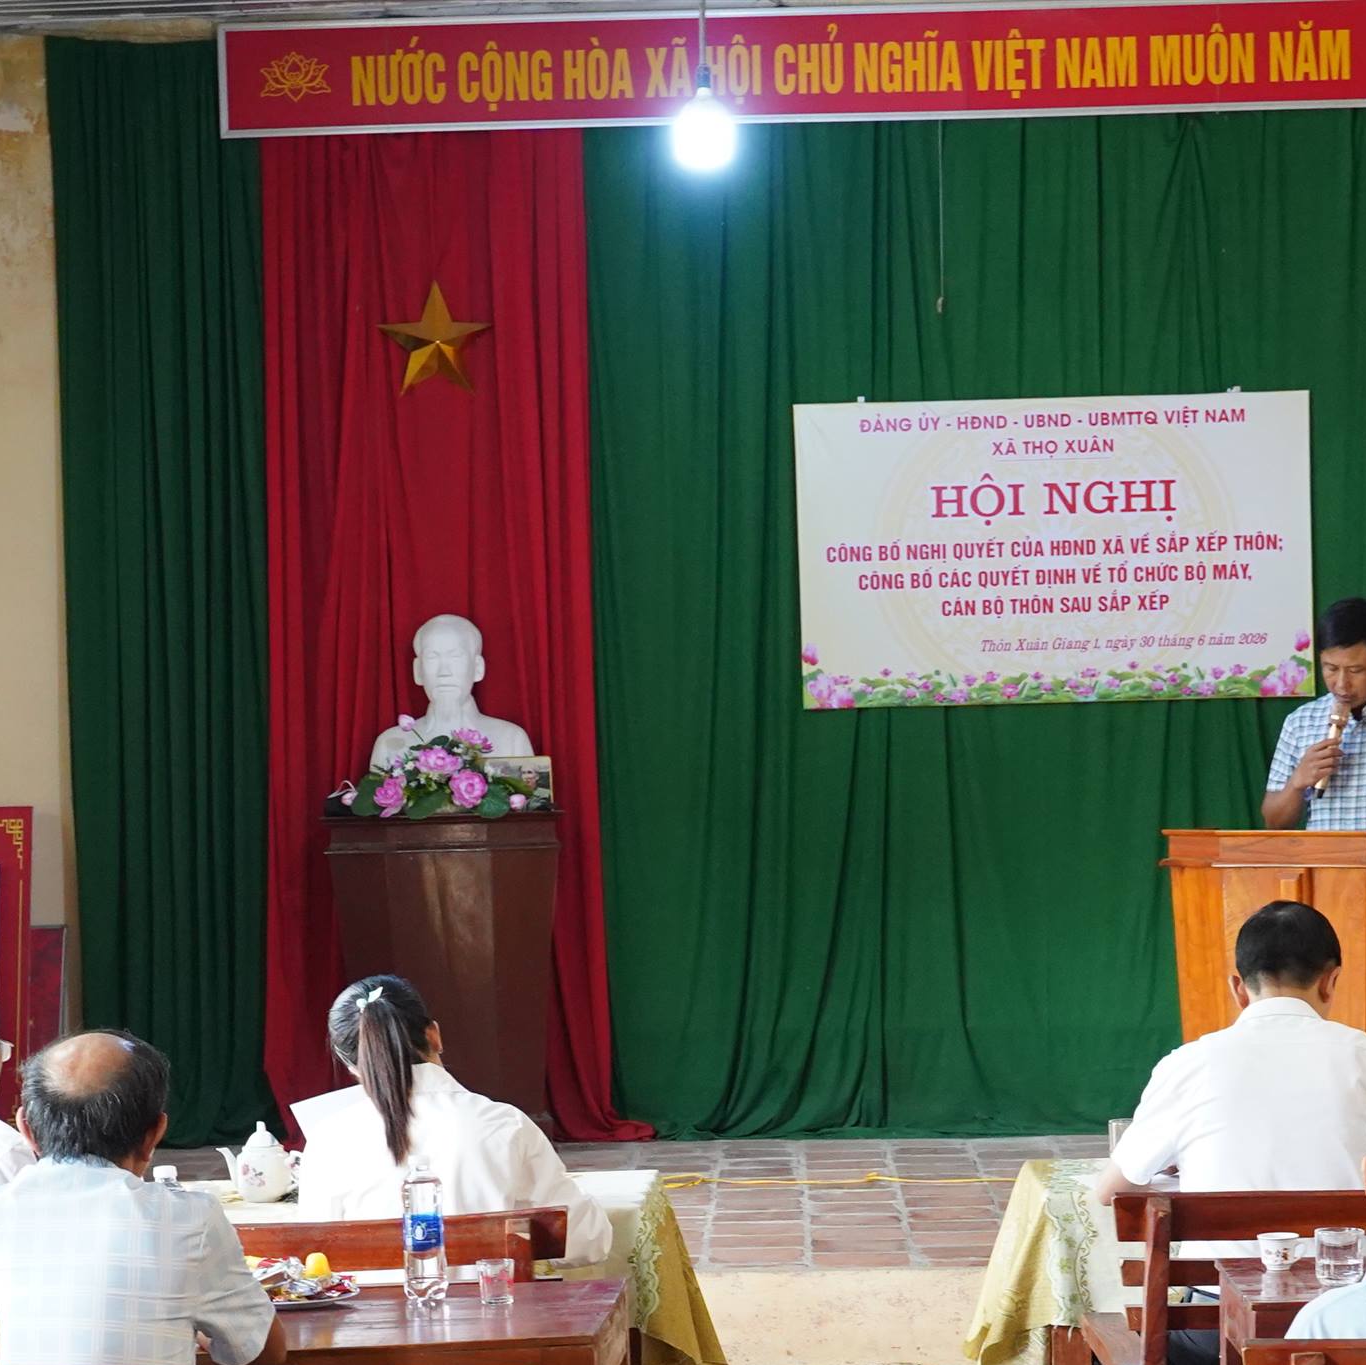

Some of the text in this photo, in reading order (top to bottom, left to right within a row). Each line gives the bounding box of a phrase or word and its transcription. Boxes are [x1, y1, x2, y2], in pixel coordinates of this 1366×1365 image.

[351, 20, 1351, 112] NƯỚC CỘNG HÒA XÃ HỘI CHỦ NGHĨA VIỆT NAM MUÔN NĂM
[859, 413, 912, 432] ĐẢNG
[918, 412, 940, 431] ỦY
[957, 415, 1007, 430] HĐND
[1024, 413, 1071, 428] UBND
[1088, 411, 1158, 427] UBMTTQ
[1164, 406, 1198, 428] VIỆT
[1205, 408, 1246, 423] NAM
[992, 436, 1114, 458] XÃ THỌ XUÂN
[930, 473, 1177, 526] HỘI NGHỊ
[826, 543, 872, 563] CÔNG
[879, 538, 900, 561] BỐ
[906, 543, 946, 563] NGHỊ
[953, 537, 1004, 560] QUYẾT
[1011, 536, 1044, 557] CỦA
[1050, 539, 1096, 556] HĐND
[1103, 535, 1125, 555] XÃ
[1156, 530, 1189, 553] SẮP
[1196, 530, 1228, 552] XẾP
[1234, 531, 1283, 551] THÔN;
[858, 571, 904, 590] CÔNG
[911, 566, 932, 589] BỐ
[939, 568, 972, 588] CÁC
[978, 564, 1029, 588] QUYẾT
[1036, 568, 1076, 588] ĐỊNH
[1108, 560, 1128, 583] TỔ
[1135, 561, 1178, 582] CHỨC
[1185, 561, 1206, 584] BỘ
[1213, 560, 1252, 581] MÁY,
[942, 589, 1170, 618] CÁN BỘ THÔN SAU SẮP XẾP
[981, 638, 1011, 652] Thôn
[1015, 638, 1048, 651] Xuân
[1052, 637, 1091, 652] Giang
[1105, 635, 1136, 652] ngày
[1139, 635, 1155, 648] 30
[1158, 634, 1195, 650] tháng
[1208, 633, 1235, 646] năm
